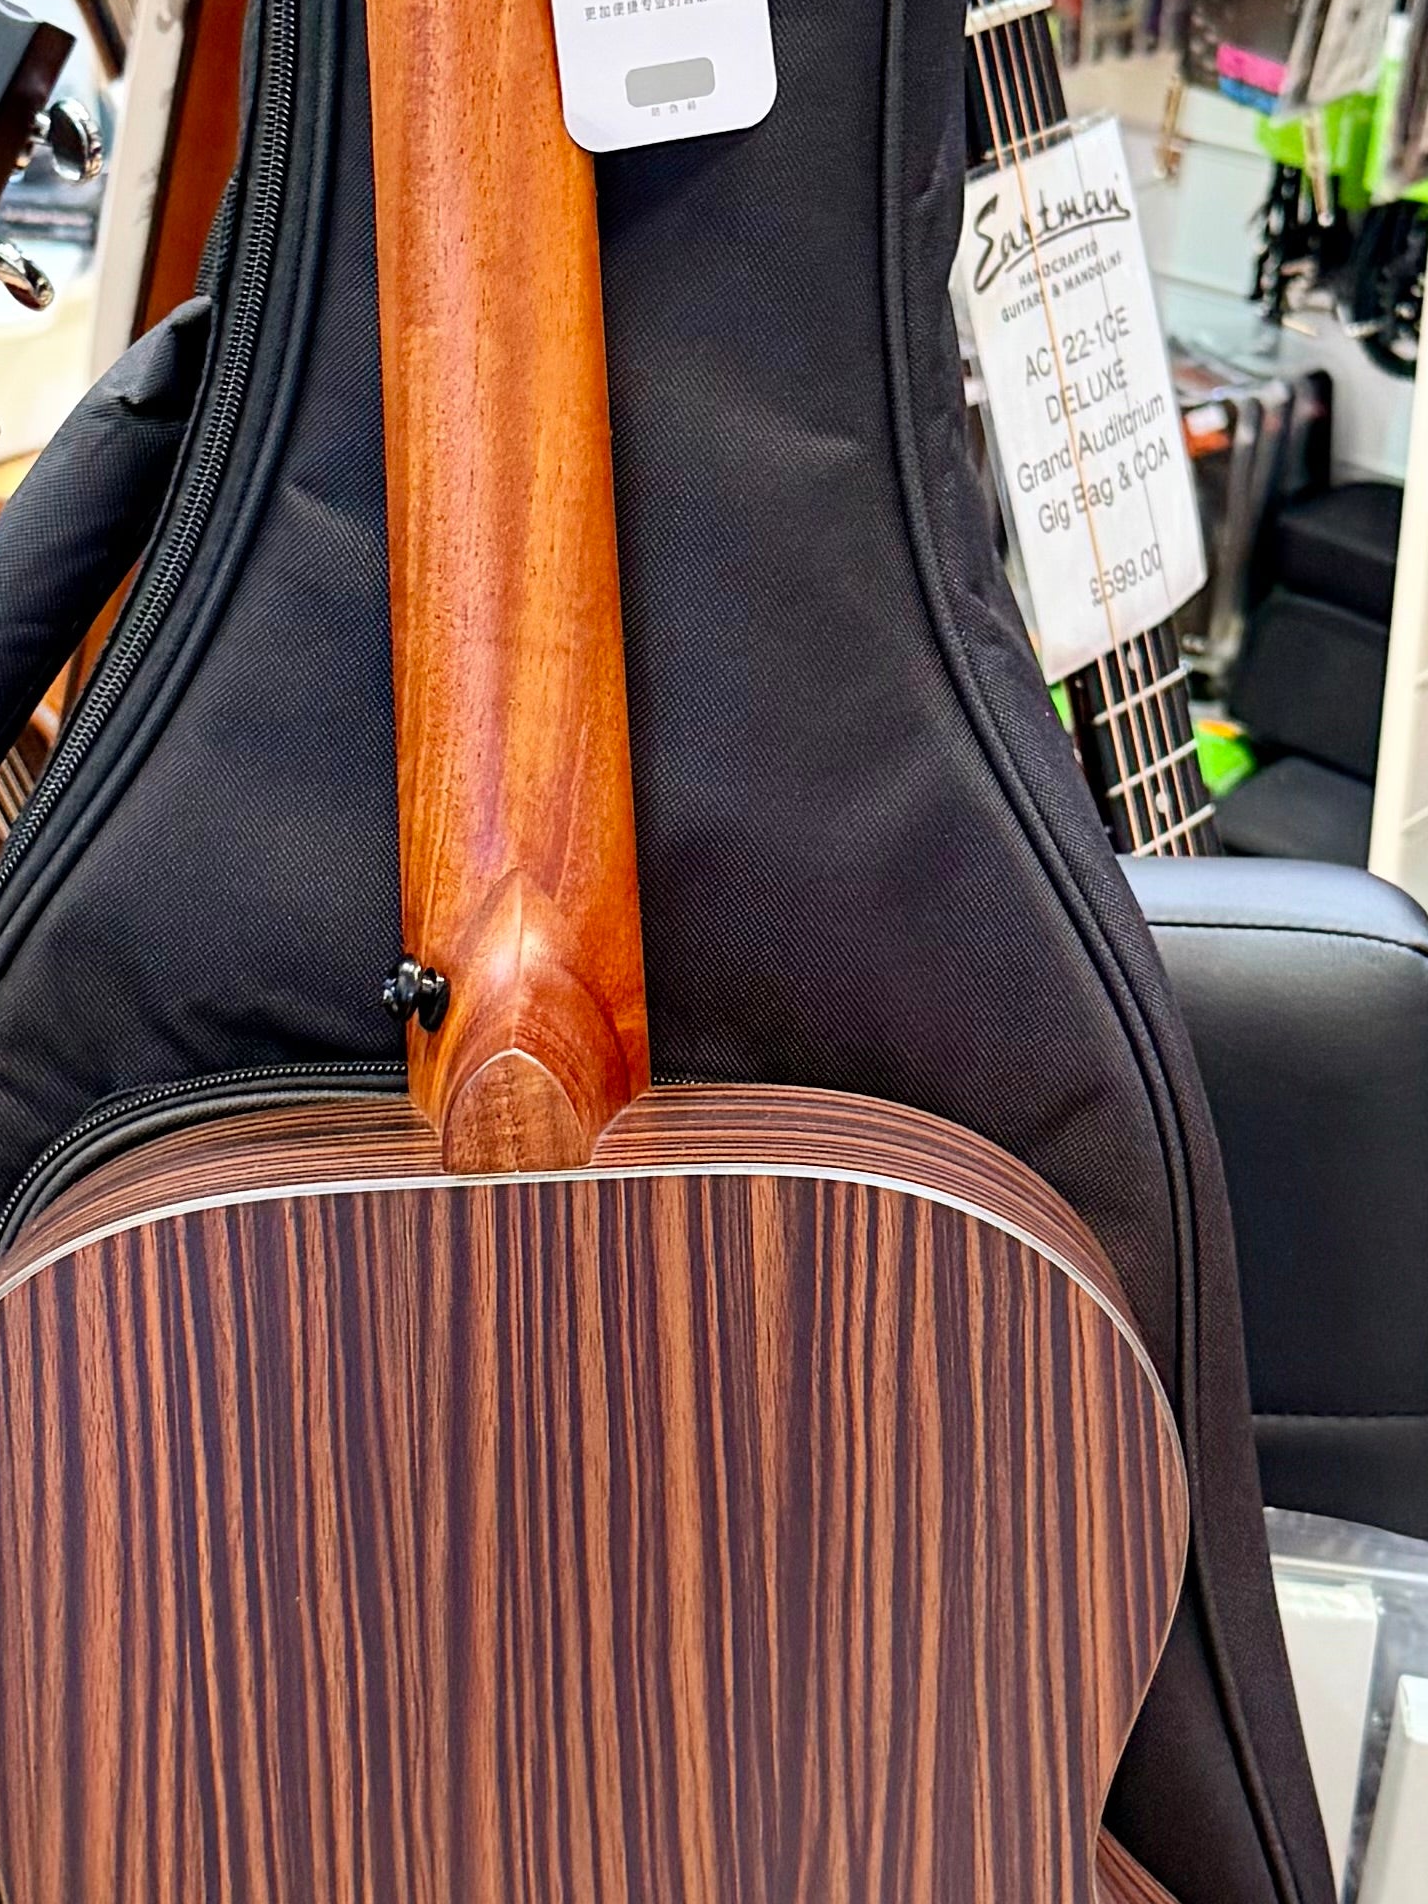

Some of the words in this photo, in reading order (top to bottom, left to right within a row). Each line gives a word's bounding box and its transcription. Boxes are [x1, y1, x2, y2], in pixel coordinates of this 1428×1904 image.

[974, 188, 1132, 295] Eastman
[1025, 306, 1131, 386] AC22-1CE
[1046, 358, 1128, 426] DELUXE
[1016, 439, 1072, 494] Grand
[1078, 393, 1166, 462] Auditorium
[1038, 496, 1071, 534] Gig
[1117, 460, 1133, 491] &
[1133, 436, 1171, 482] COA
